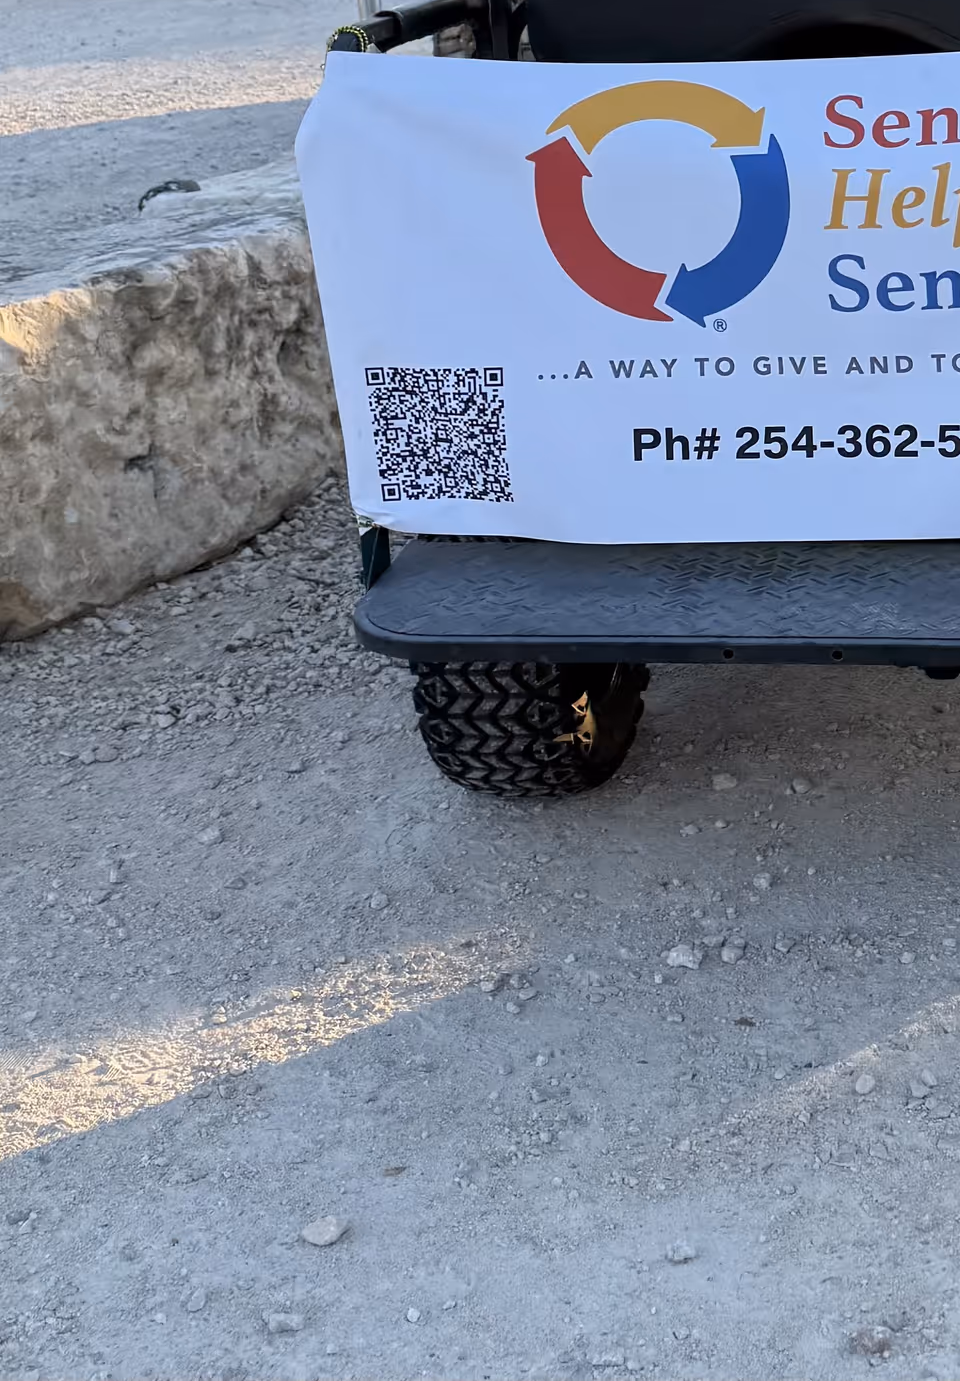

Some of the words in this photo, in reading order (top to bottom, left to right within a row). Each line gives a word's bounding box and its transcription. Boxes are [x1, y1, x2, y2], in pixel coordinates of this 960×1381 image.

[608, 358, 678, 379] WAY
[693, 356, 735, 377] TO
[752, 355, 828, 376] GIVE
[844, 355, 914, 375] AND
[632, 426, 721, 462] Ph#
